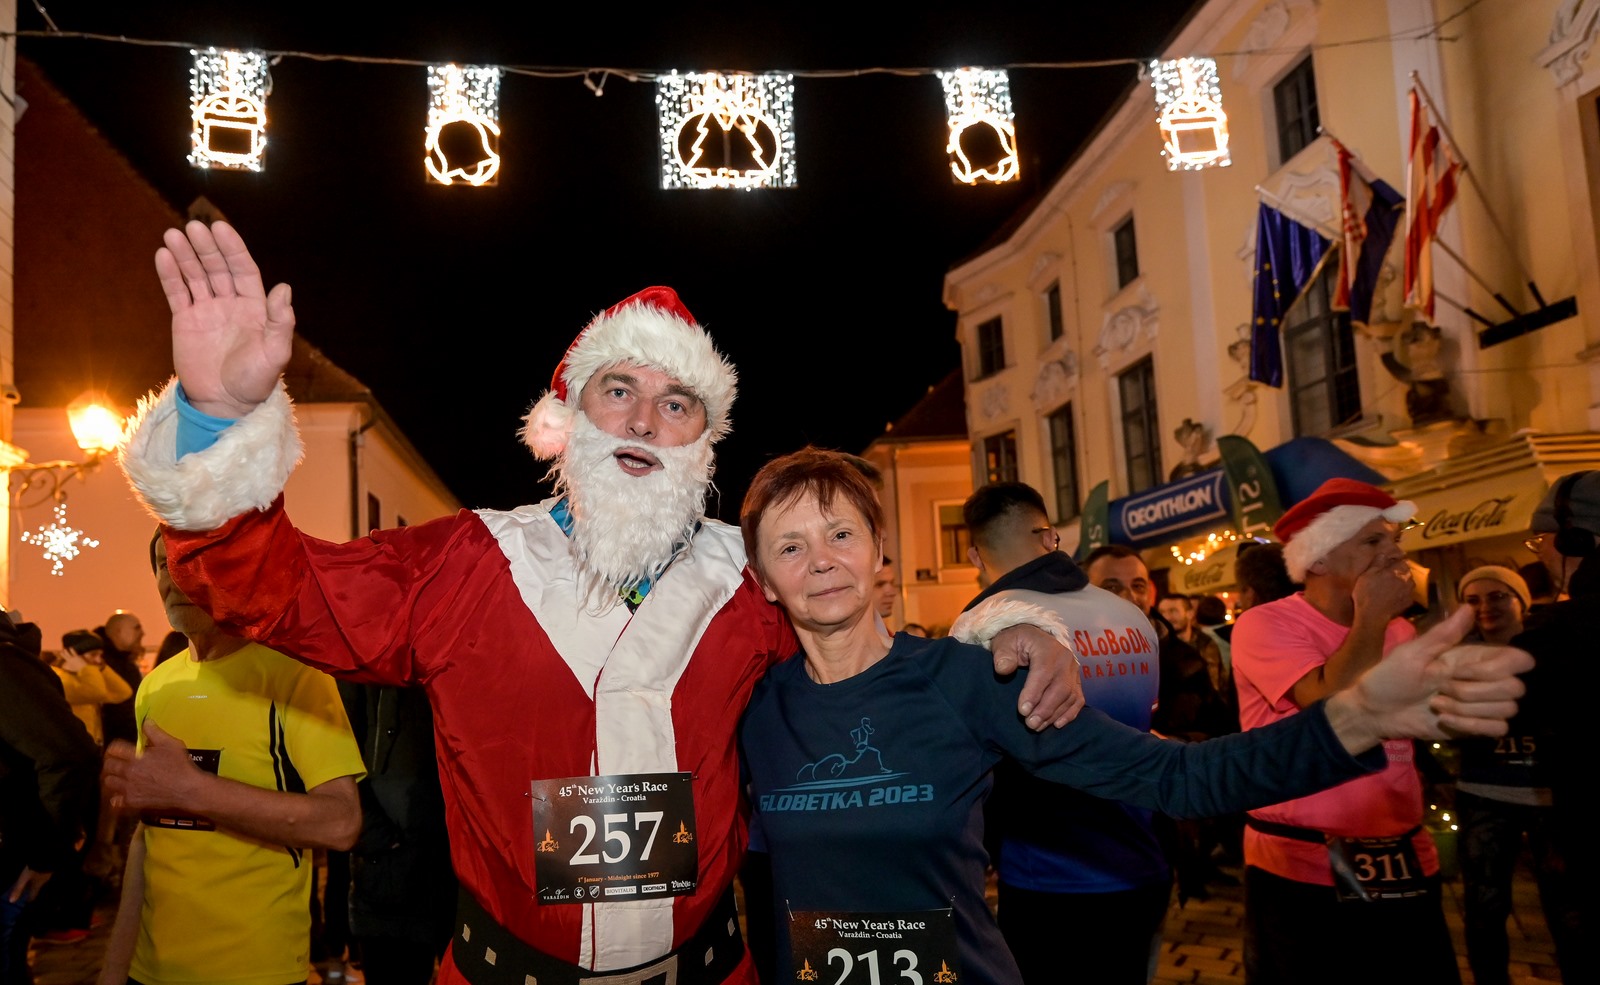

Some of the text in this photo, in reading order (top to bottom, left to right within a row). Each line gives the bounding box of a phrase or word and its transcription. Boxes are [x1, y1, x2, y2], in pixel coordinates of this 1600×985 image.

[1127, 484, 1212, 529] DECATHLON
[1082, 659, 1149, 679] RAŽDIN
[1493, 735, 1537, 754] 215
[578, 785, 605, 796] New
[607, 782, 640, 794] Year's
[642, 781, 668, 793] Race
[759, 784, 934, 812] GLOBETKA 2023
[582, 795, 616, 804] Varaždin
[621, 794, 647, 802] Croatia
[569, 811, 664, 866] 257
[1354, 852, 1412, 881] 311
[814, 917, 926, 930] 45th New Year's Race
[838, 930, 871, 939] Varaždin
[876, 931, 903, 939] Croatia
[826, 947, 925, 985] 213
